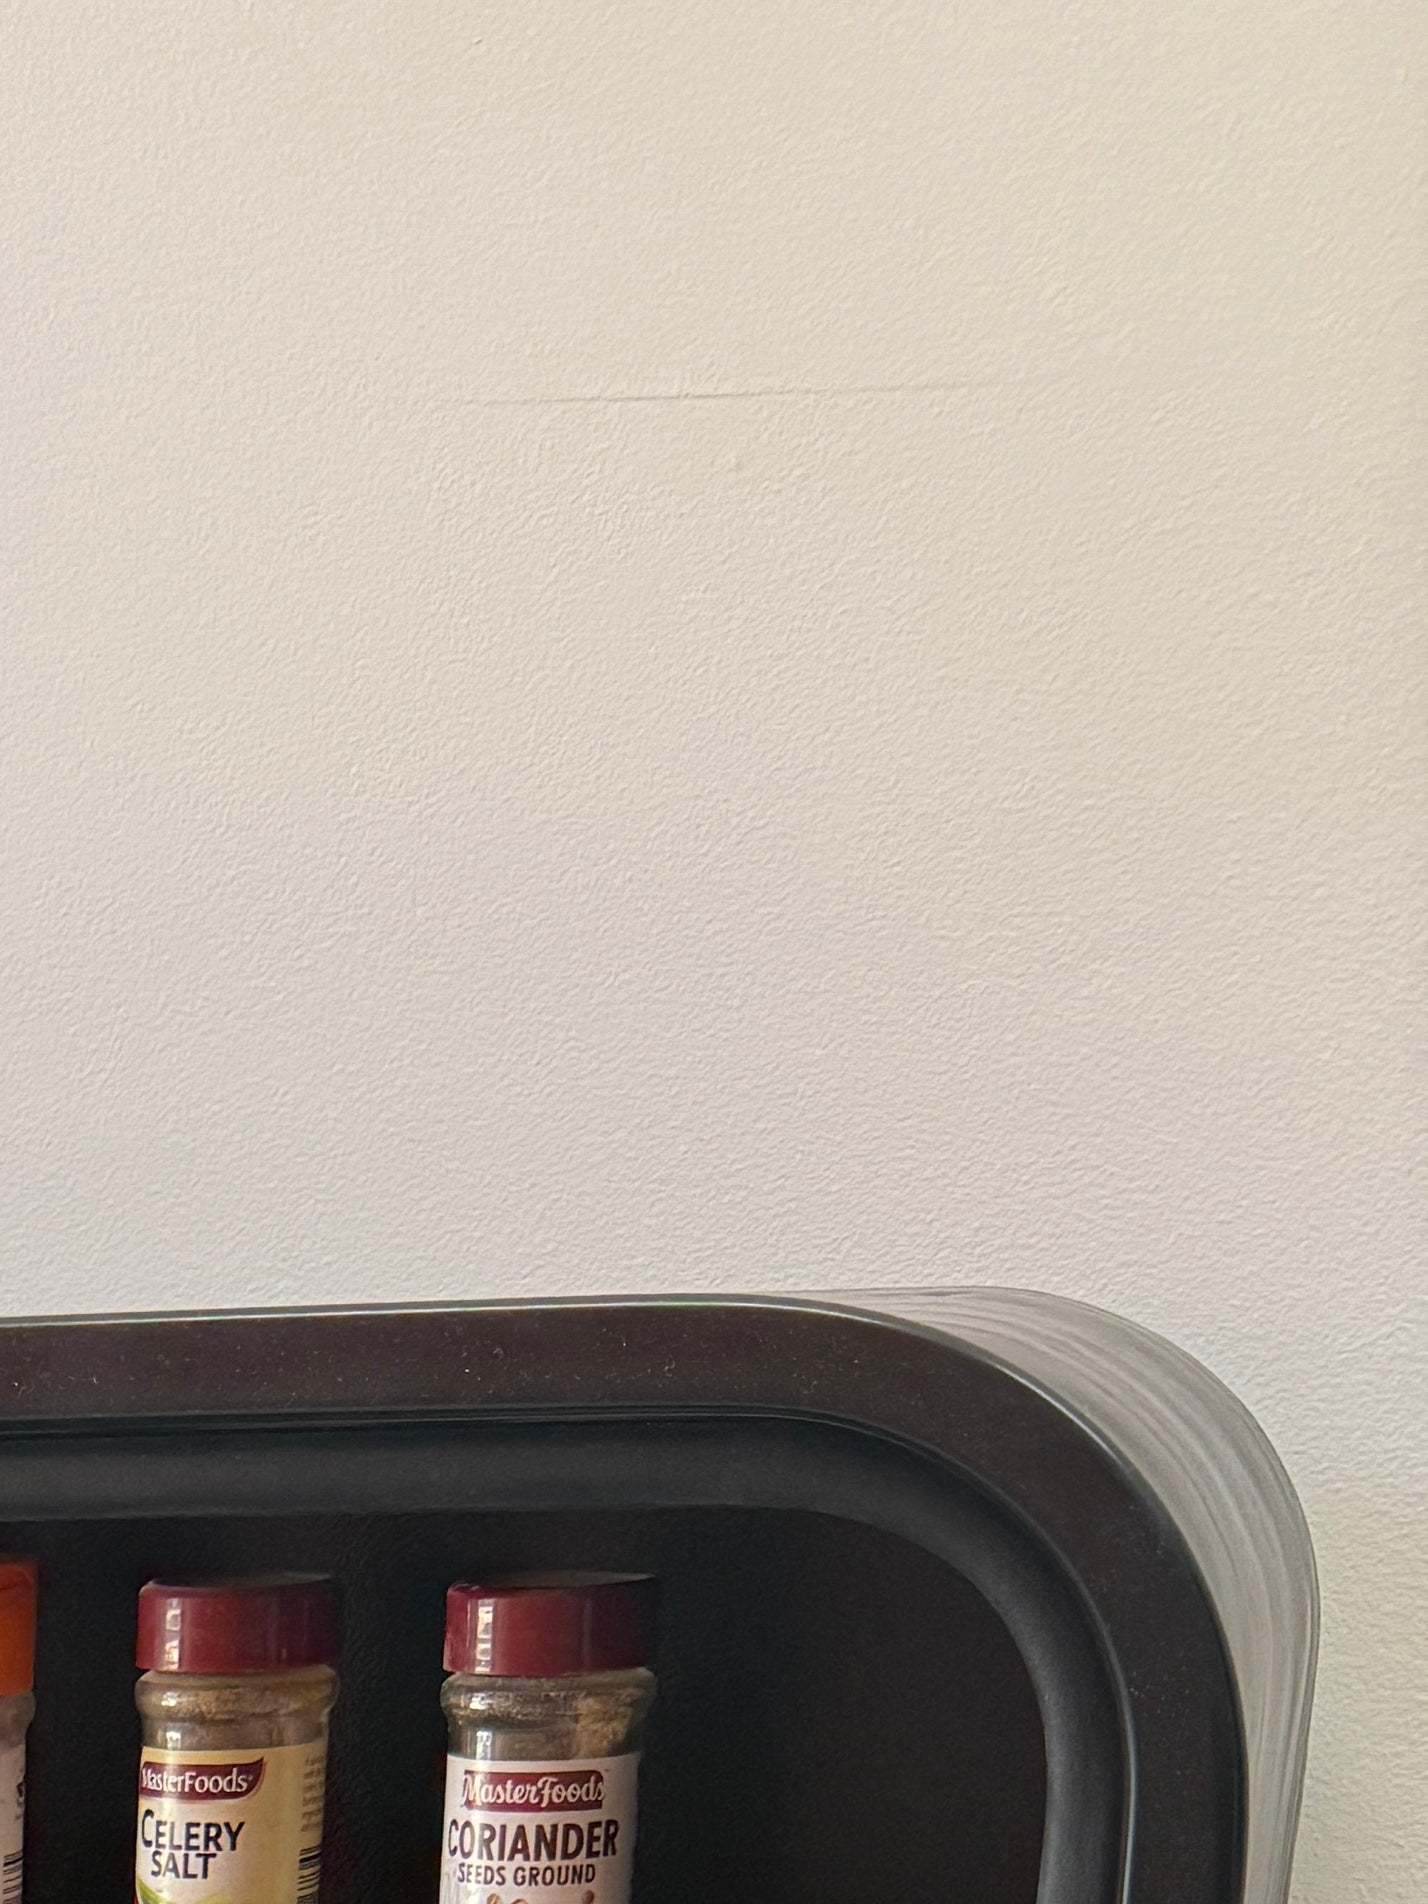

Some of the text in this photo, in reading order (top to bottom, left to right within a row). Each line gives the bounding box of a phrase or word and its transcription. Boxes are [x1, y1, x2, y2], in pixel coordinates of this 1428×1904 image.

[462, 1775, 605, 1807] MasterFoods
[142, 1809, 245, 1851] CELERY
[448, 1819, 619, 1862] CORIANDER
[151, 1850, 217, 1880] SALT
[458, 1863, 596, 1886] SEEDS GROUND
